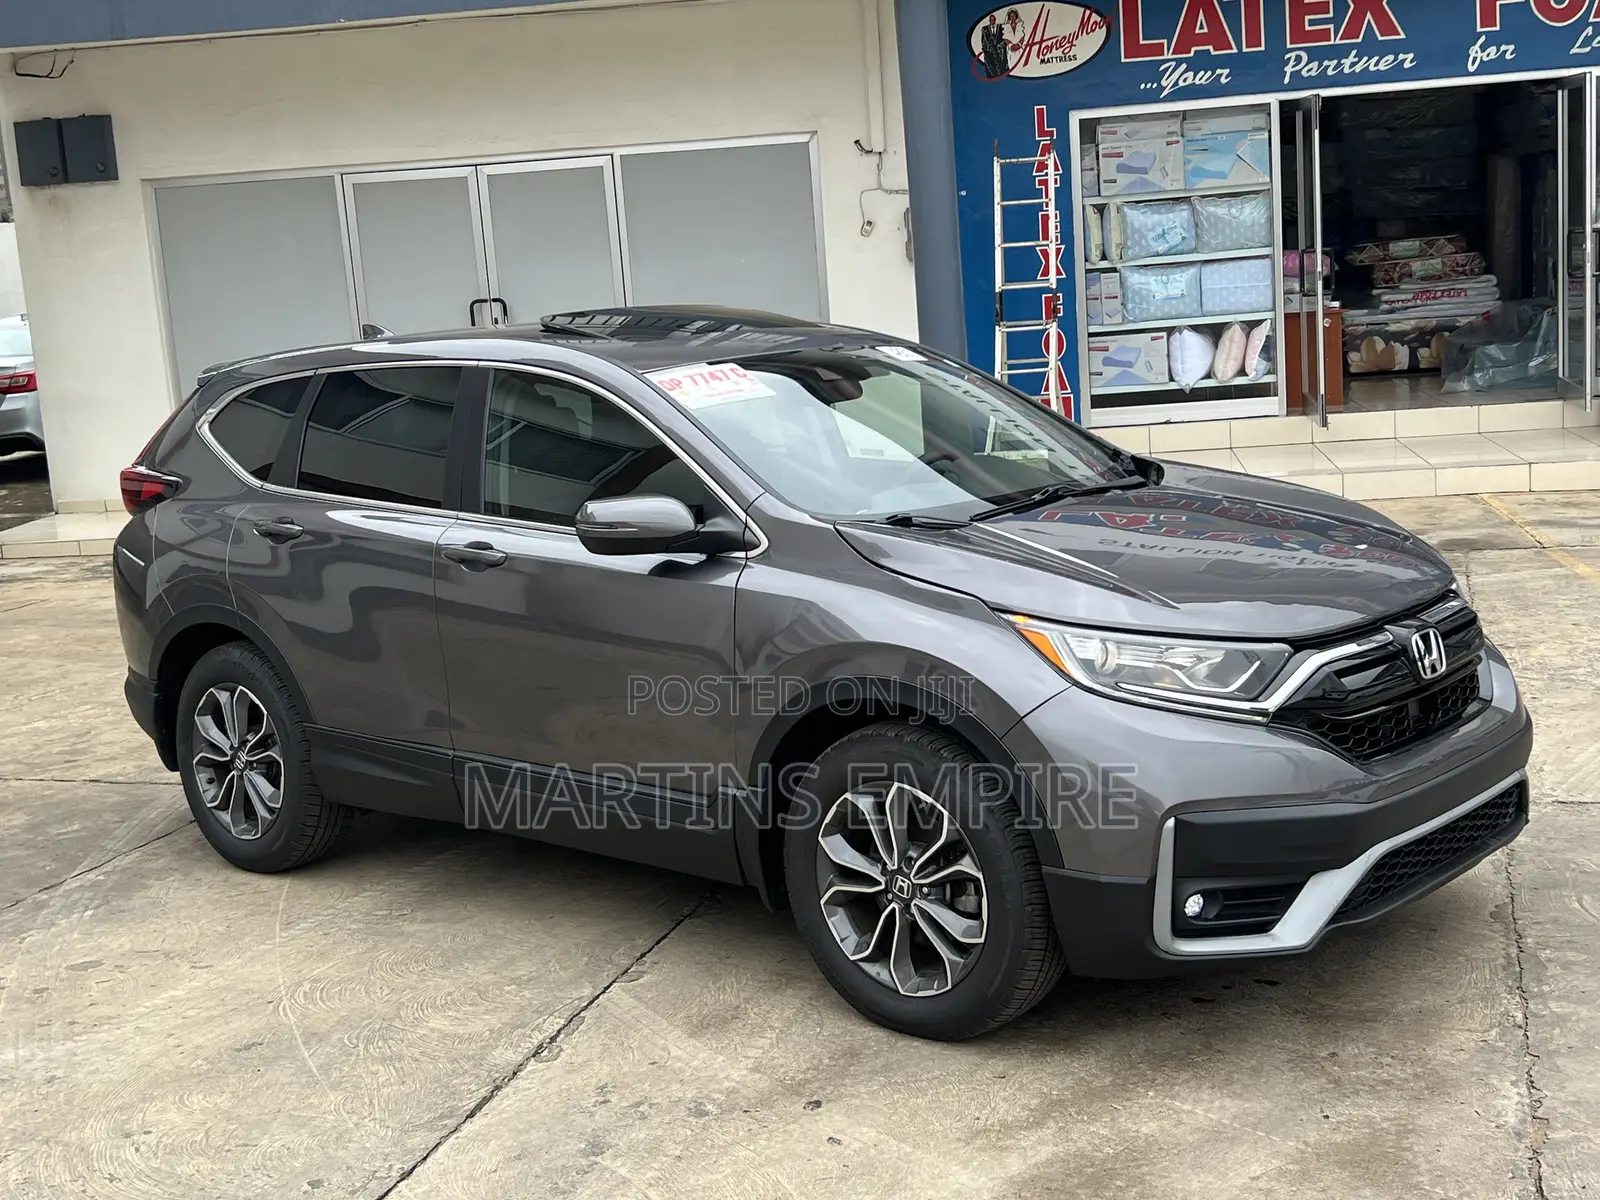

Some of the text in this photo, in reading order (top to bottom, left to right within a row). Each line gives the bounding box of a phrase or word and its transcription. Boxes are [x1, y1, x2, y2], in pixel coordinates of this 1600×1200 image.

[1119, 0, 1407, 62] LATEX
[1039, 53, 1078, 66] MATTRESS
[1283, 49, 1417, 84] Partner
[1467, 34, 1517, 73] for
